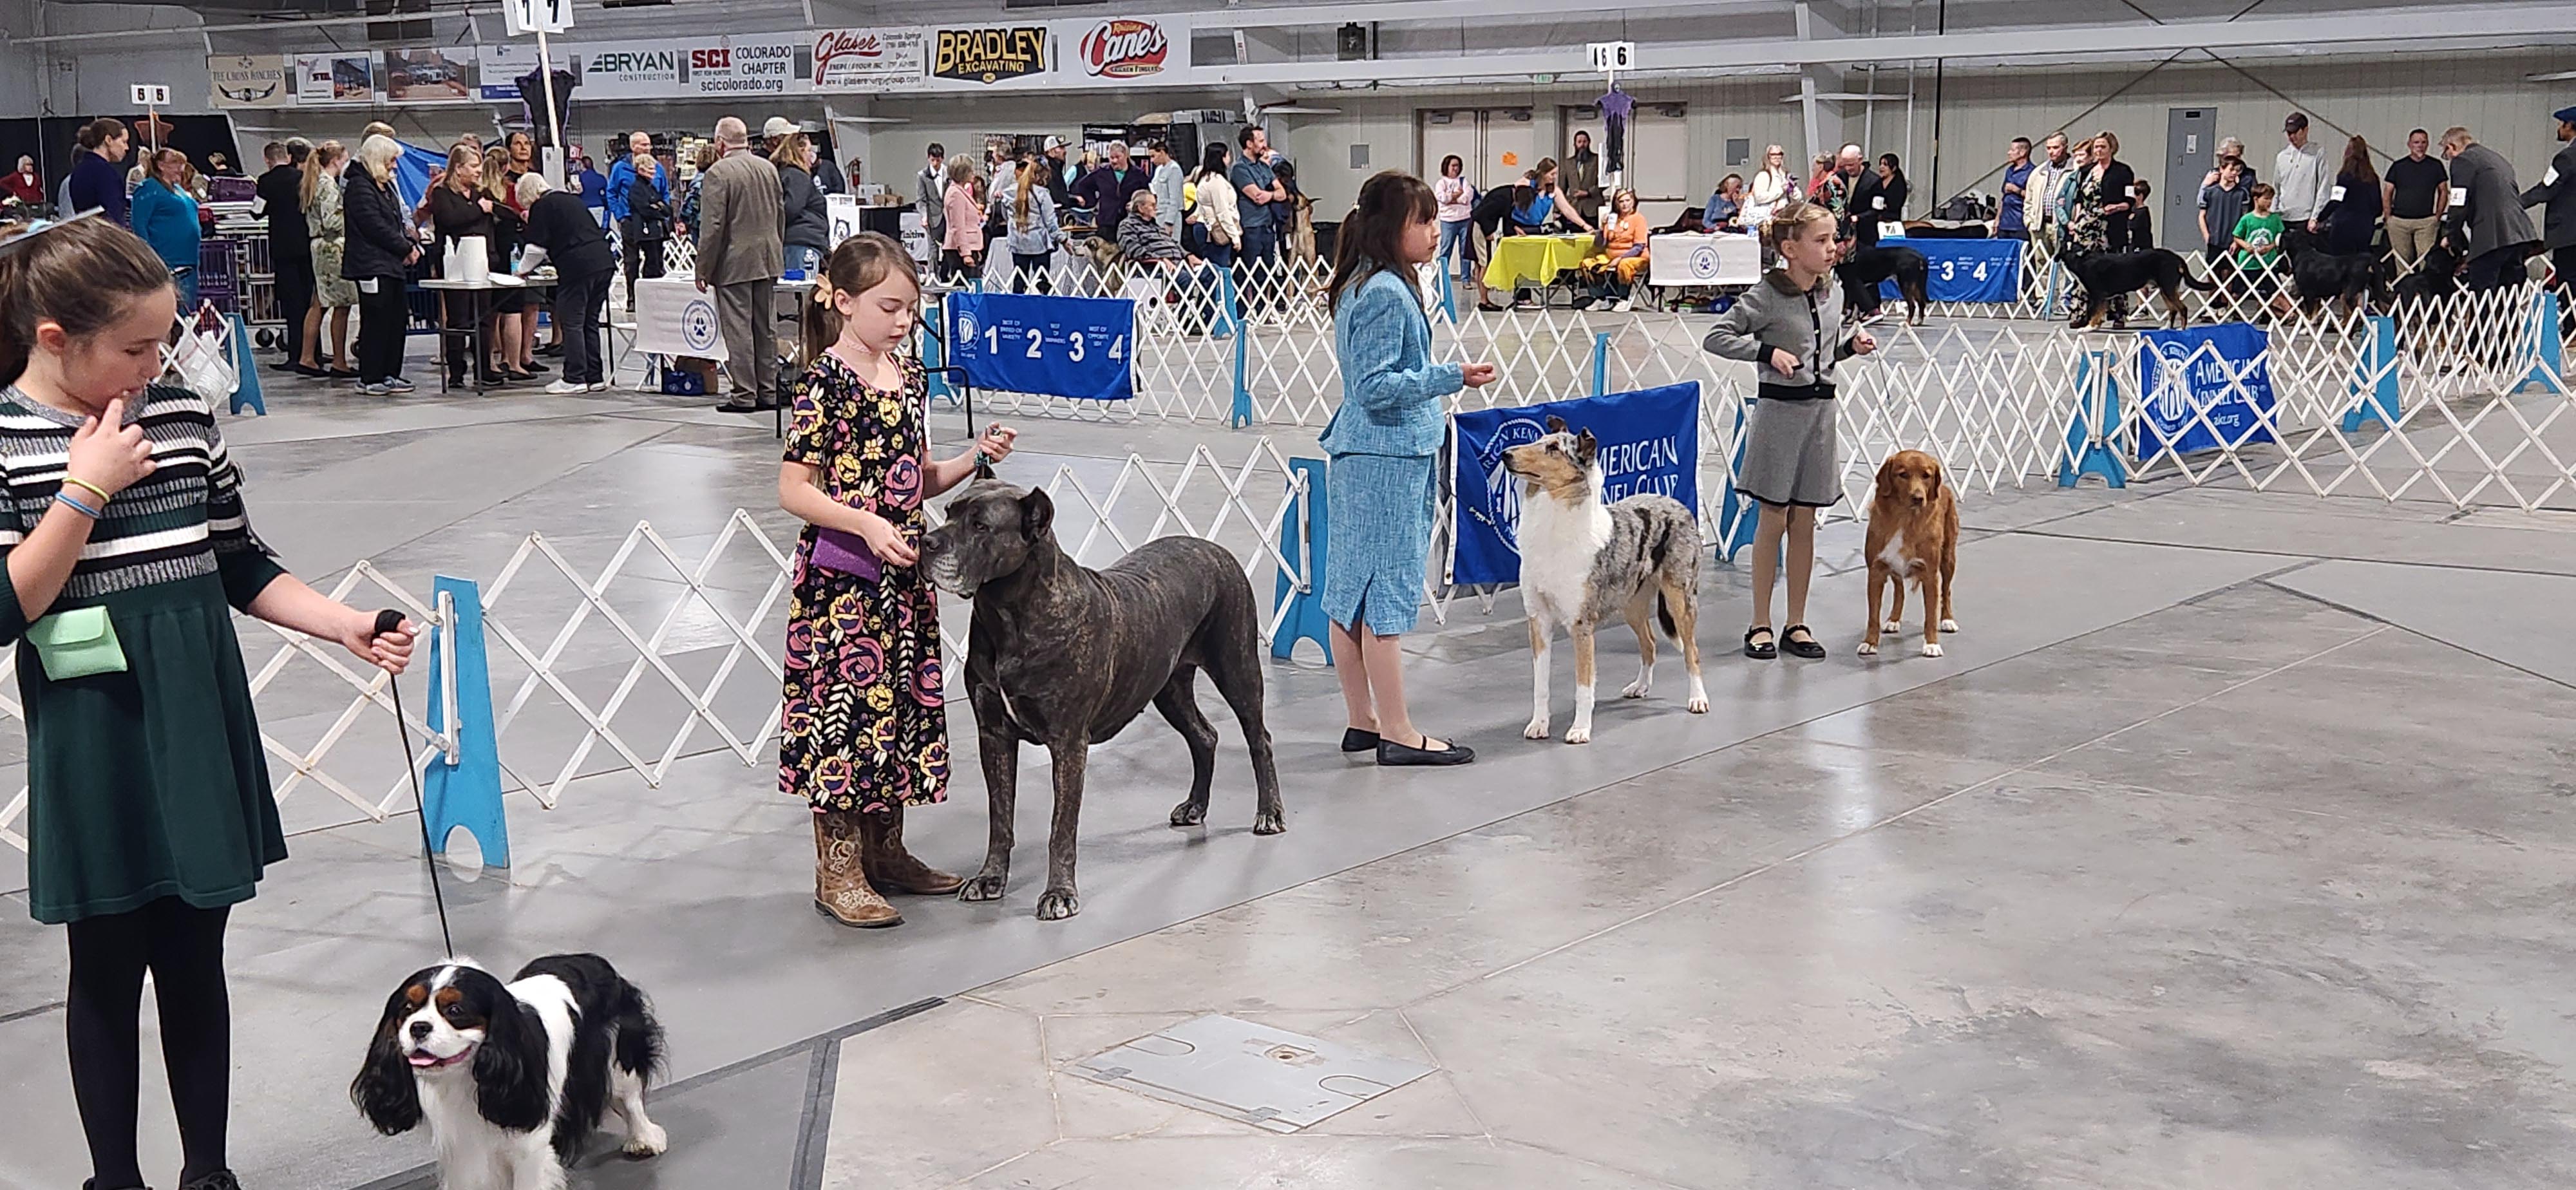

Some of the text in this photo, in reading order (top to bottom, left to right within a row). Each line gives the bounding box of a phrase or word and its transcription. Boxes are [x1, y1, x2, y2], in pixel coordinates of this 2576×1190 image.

[735, 46, 791, 59] COLORADO
[815, 31, 882, 85] Glaser
[936, 30, 1046, 74] BRADLEY
[1083, 20, 1168, 76] Cane's
[1602, 47, 1607, 68] 6
[1617, 46, 1627, 66] 6
[604, 51, 674, 72] BRYAN
[692, 49, 731, 69] SCI
[741, 62, 786, 75] CHAPTER
[958, 61, 1024, 74] EXCAVATING
[619, 73, 675, 82] CONSTRUCTION
[701, 78, 783, 92] scicolorado.org
[1940, 261, 1955, 281] 3
[1973, 261, 1987, 281] 4
[985, 325, 998, 355] 1
[1026, 328, 1043, 359] 2
[1068, 331, 1084, 362] 3
[1108, 334, 1123, 361] 4
[2195, 358, 2261, 387] AMECAN
[1512, 426, 1541, 442] KENN
[1598, 435, 1679, 477] MERICAN
[1602, 483, 1628, 505] NEL
